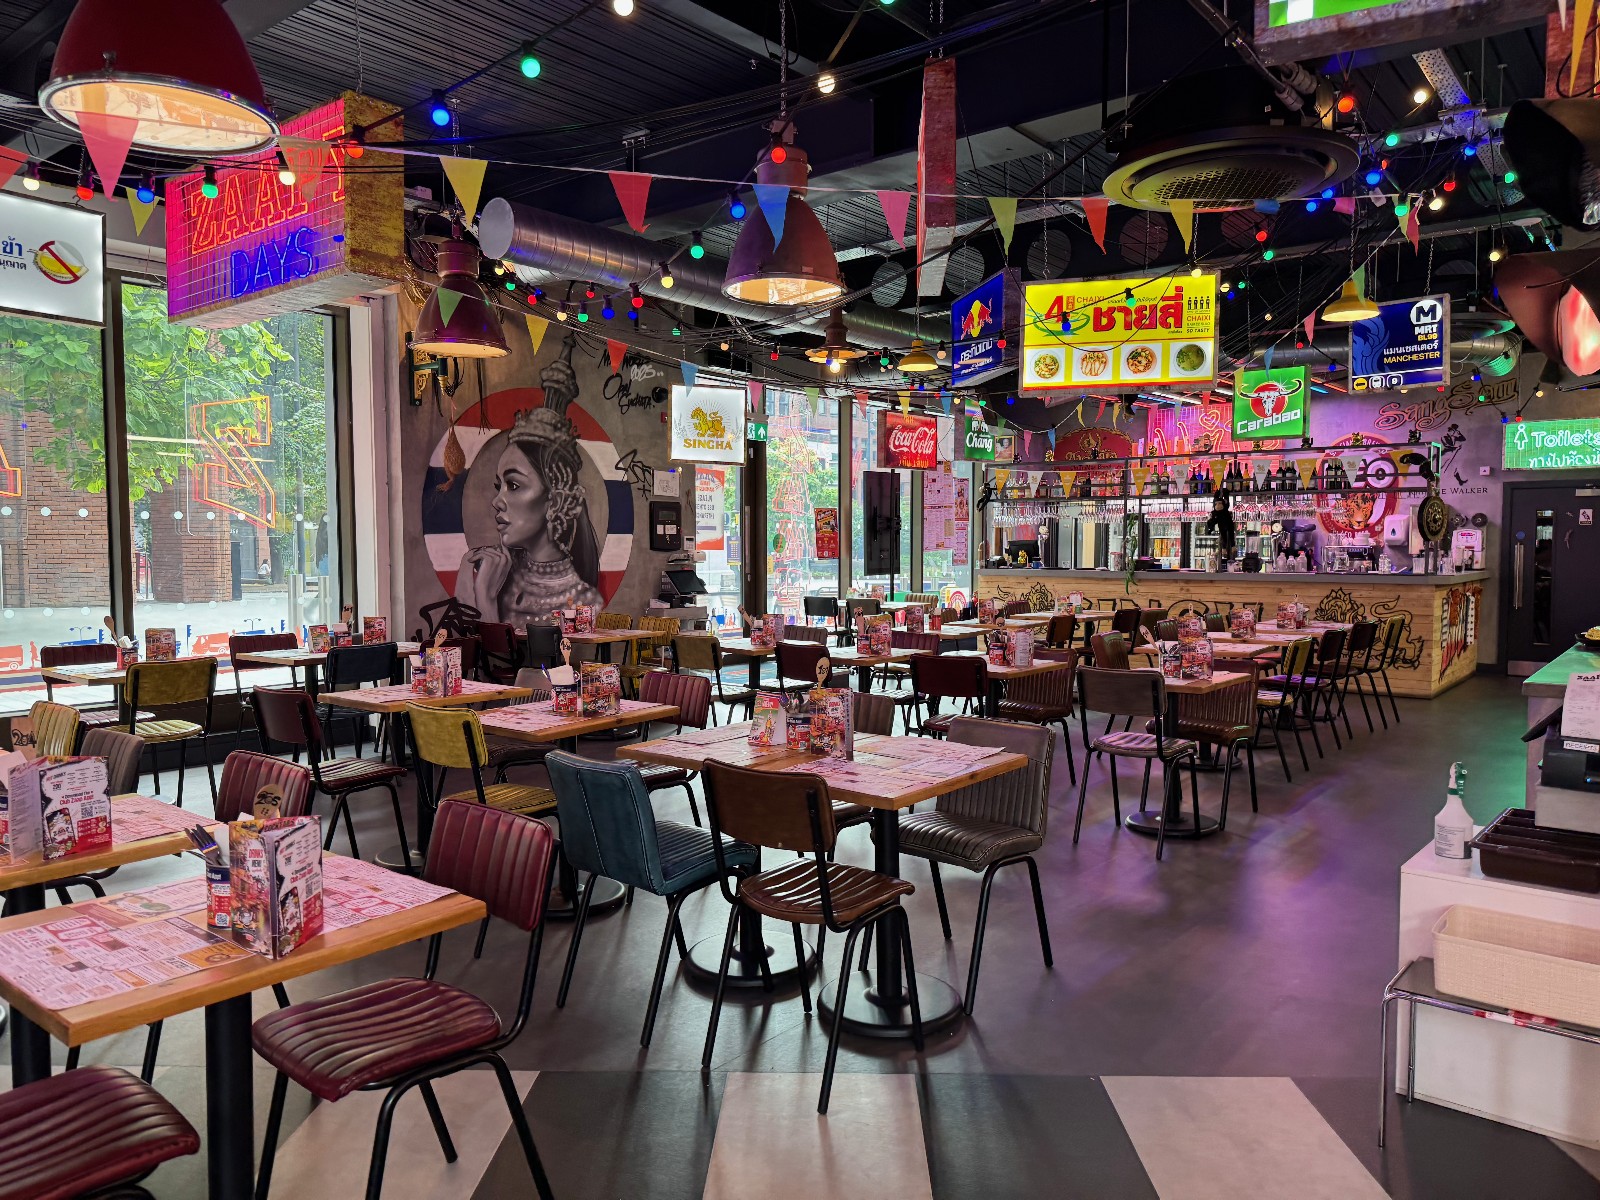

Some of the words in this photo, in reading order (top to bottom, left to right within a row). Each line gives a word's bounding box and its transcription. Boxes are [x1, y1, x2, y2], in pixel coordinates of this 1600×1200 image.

[231, 227, 314, 298] DAYS
[1186, 314, 1211, 322] CHAIXI
[1415, 303, 1438, 323] M
[1414, 324, 1438, 335] MRT
[1383, 351, 1440, 364] MANCHESTER
[1236, 408, 1302, 435] Carabao
[683, 438, 733, 451] SINGHA
[966, 431, 993, 452] Chang
